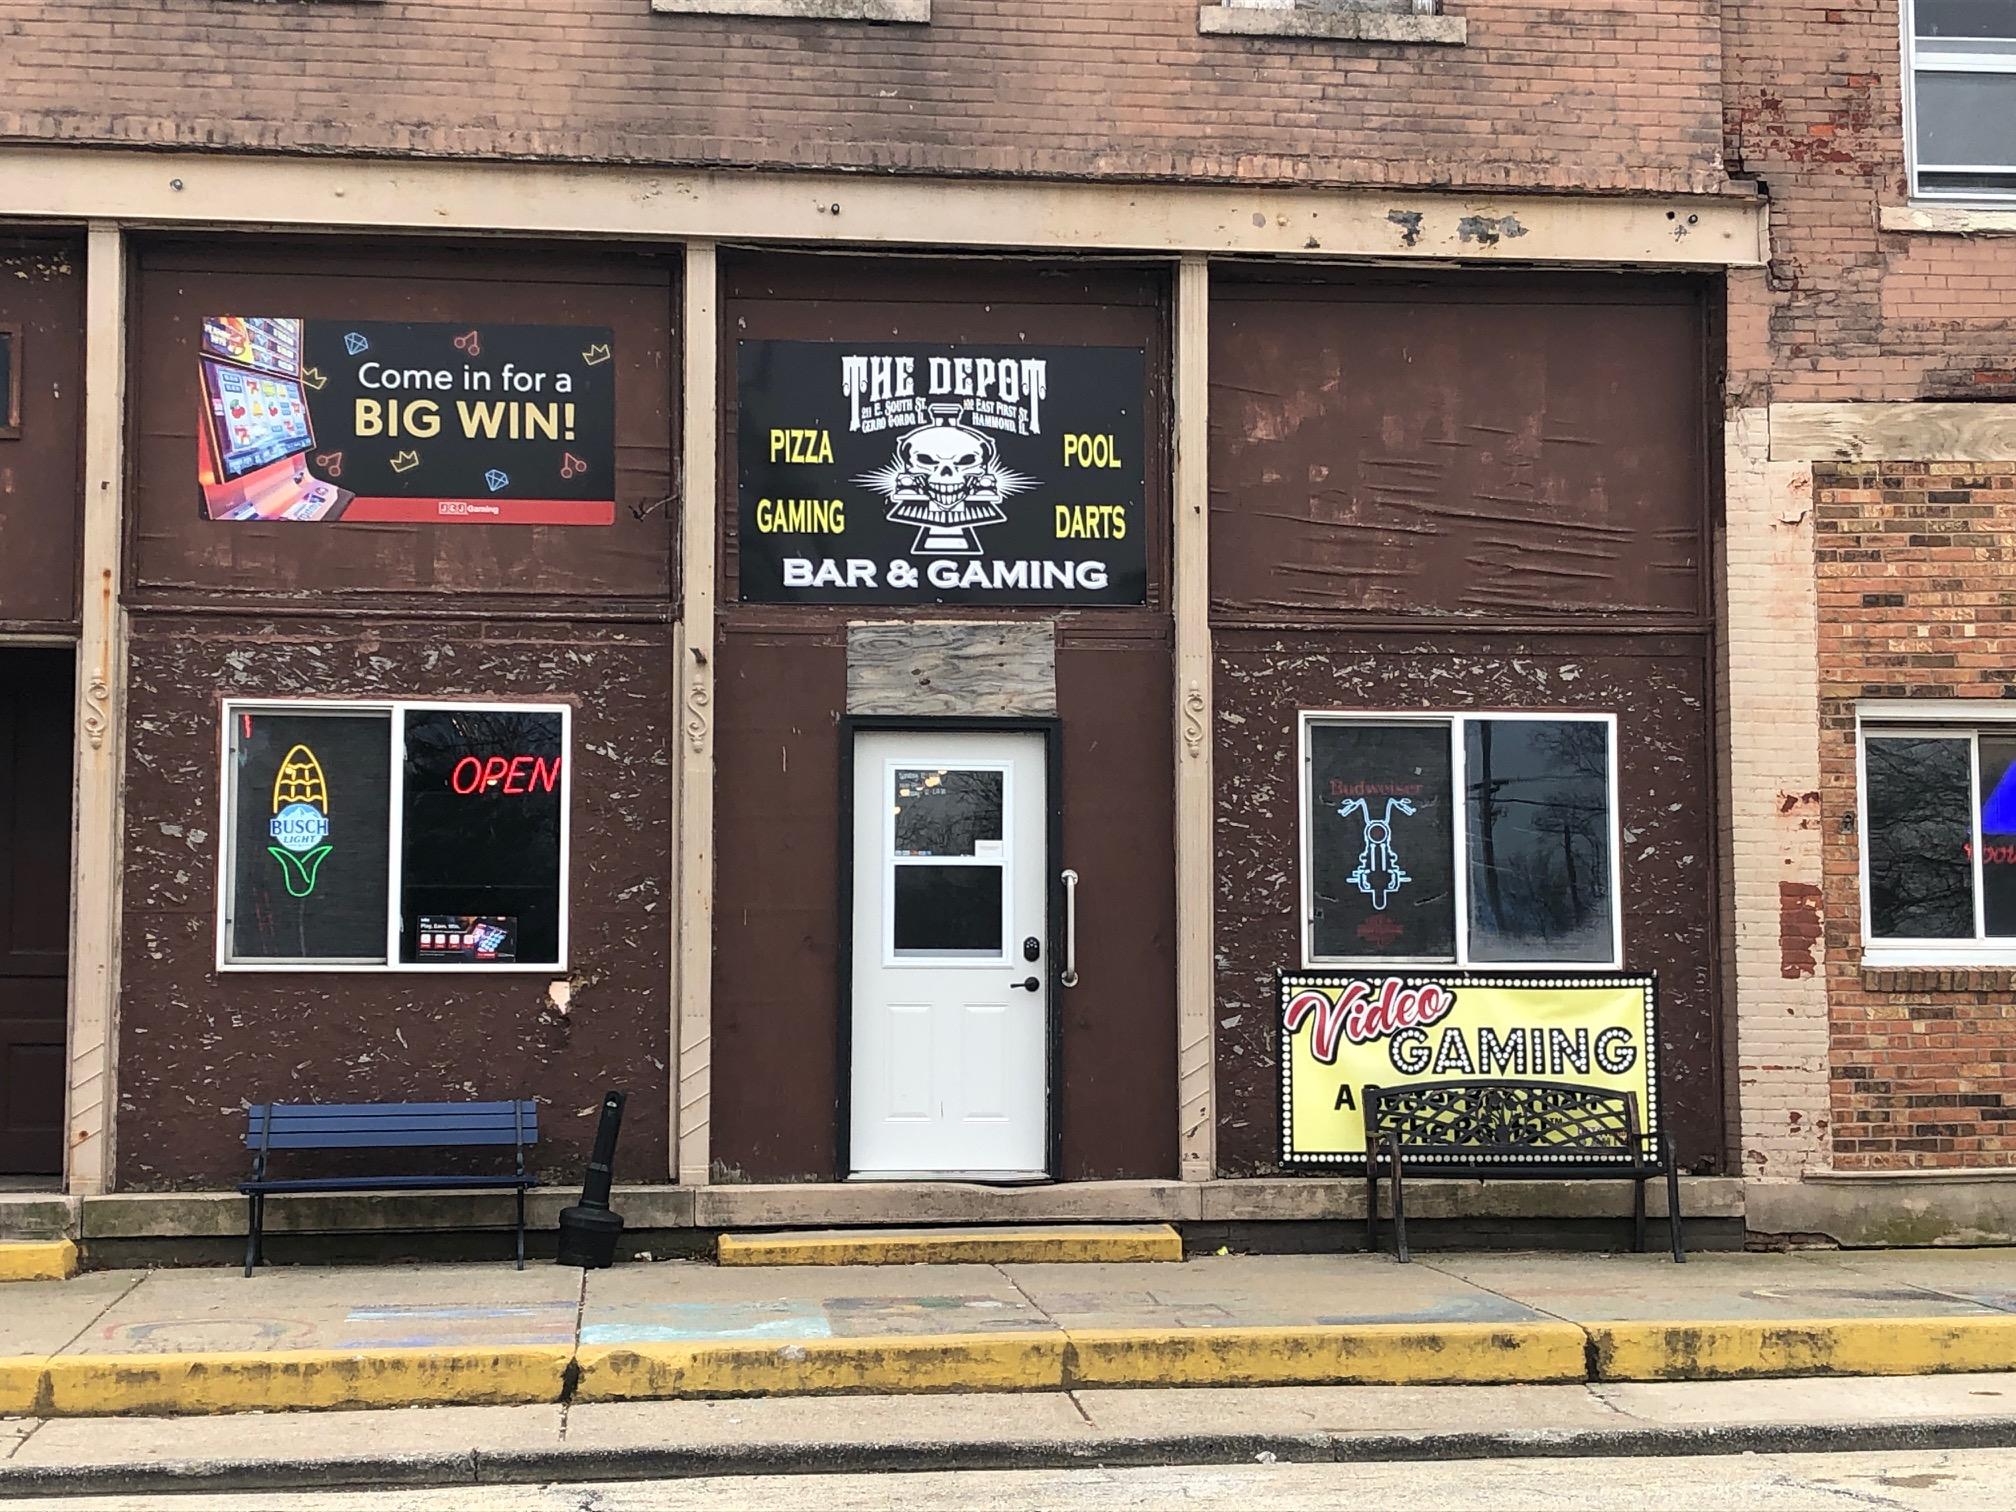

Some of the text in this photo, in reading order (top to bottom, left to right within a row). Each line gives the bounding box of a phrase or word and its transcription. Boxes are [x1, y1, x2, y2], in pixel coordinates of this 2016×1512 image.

[358, 362, 573, 393] Come in for a
[841, 354, 1047, 435] THE DEPOT
[874, 402, 883, 416] E.
[885, 399, 913, 416] SOUTH
[915, 397, 927, 413] ST.
[976, 398, 995, 414] EAST
[996, 401, 1017, 419] FIRST
[355, 399, 576, 440] BIG WIN!
[862, 417, 886, 434] CERRO
[770, 429, 834, 464] PIZZA
[1064, 434, 1122, 469] POOL
[467, 505, 499, 515] Gaming
[756, 499, 845, 534] GAMING
[1055, 505, 1126, 539] DARTS
[783, 558, 1109, 590] BAR & GAMING
[452, 756, 562, 795] OPEN
[1329, 778, 1424, 796] Budweiser
[272, 819, 328, 835] BUSCH
[284, 836, 316, 844] LIGHT
[1284, 978, 1453, 1062] Video
[1389, 1026, 1637, 1077] GAMING
[1334, 1084, 1356, 1111] A
